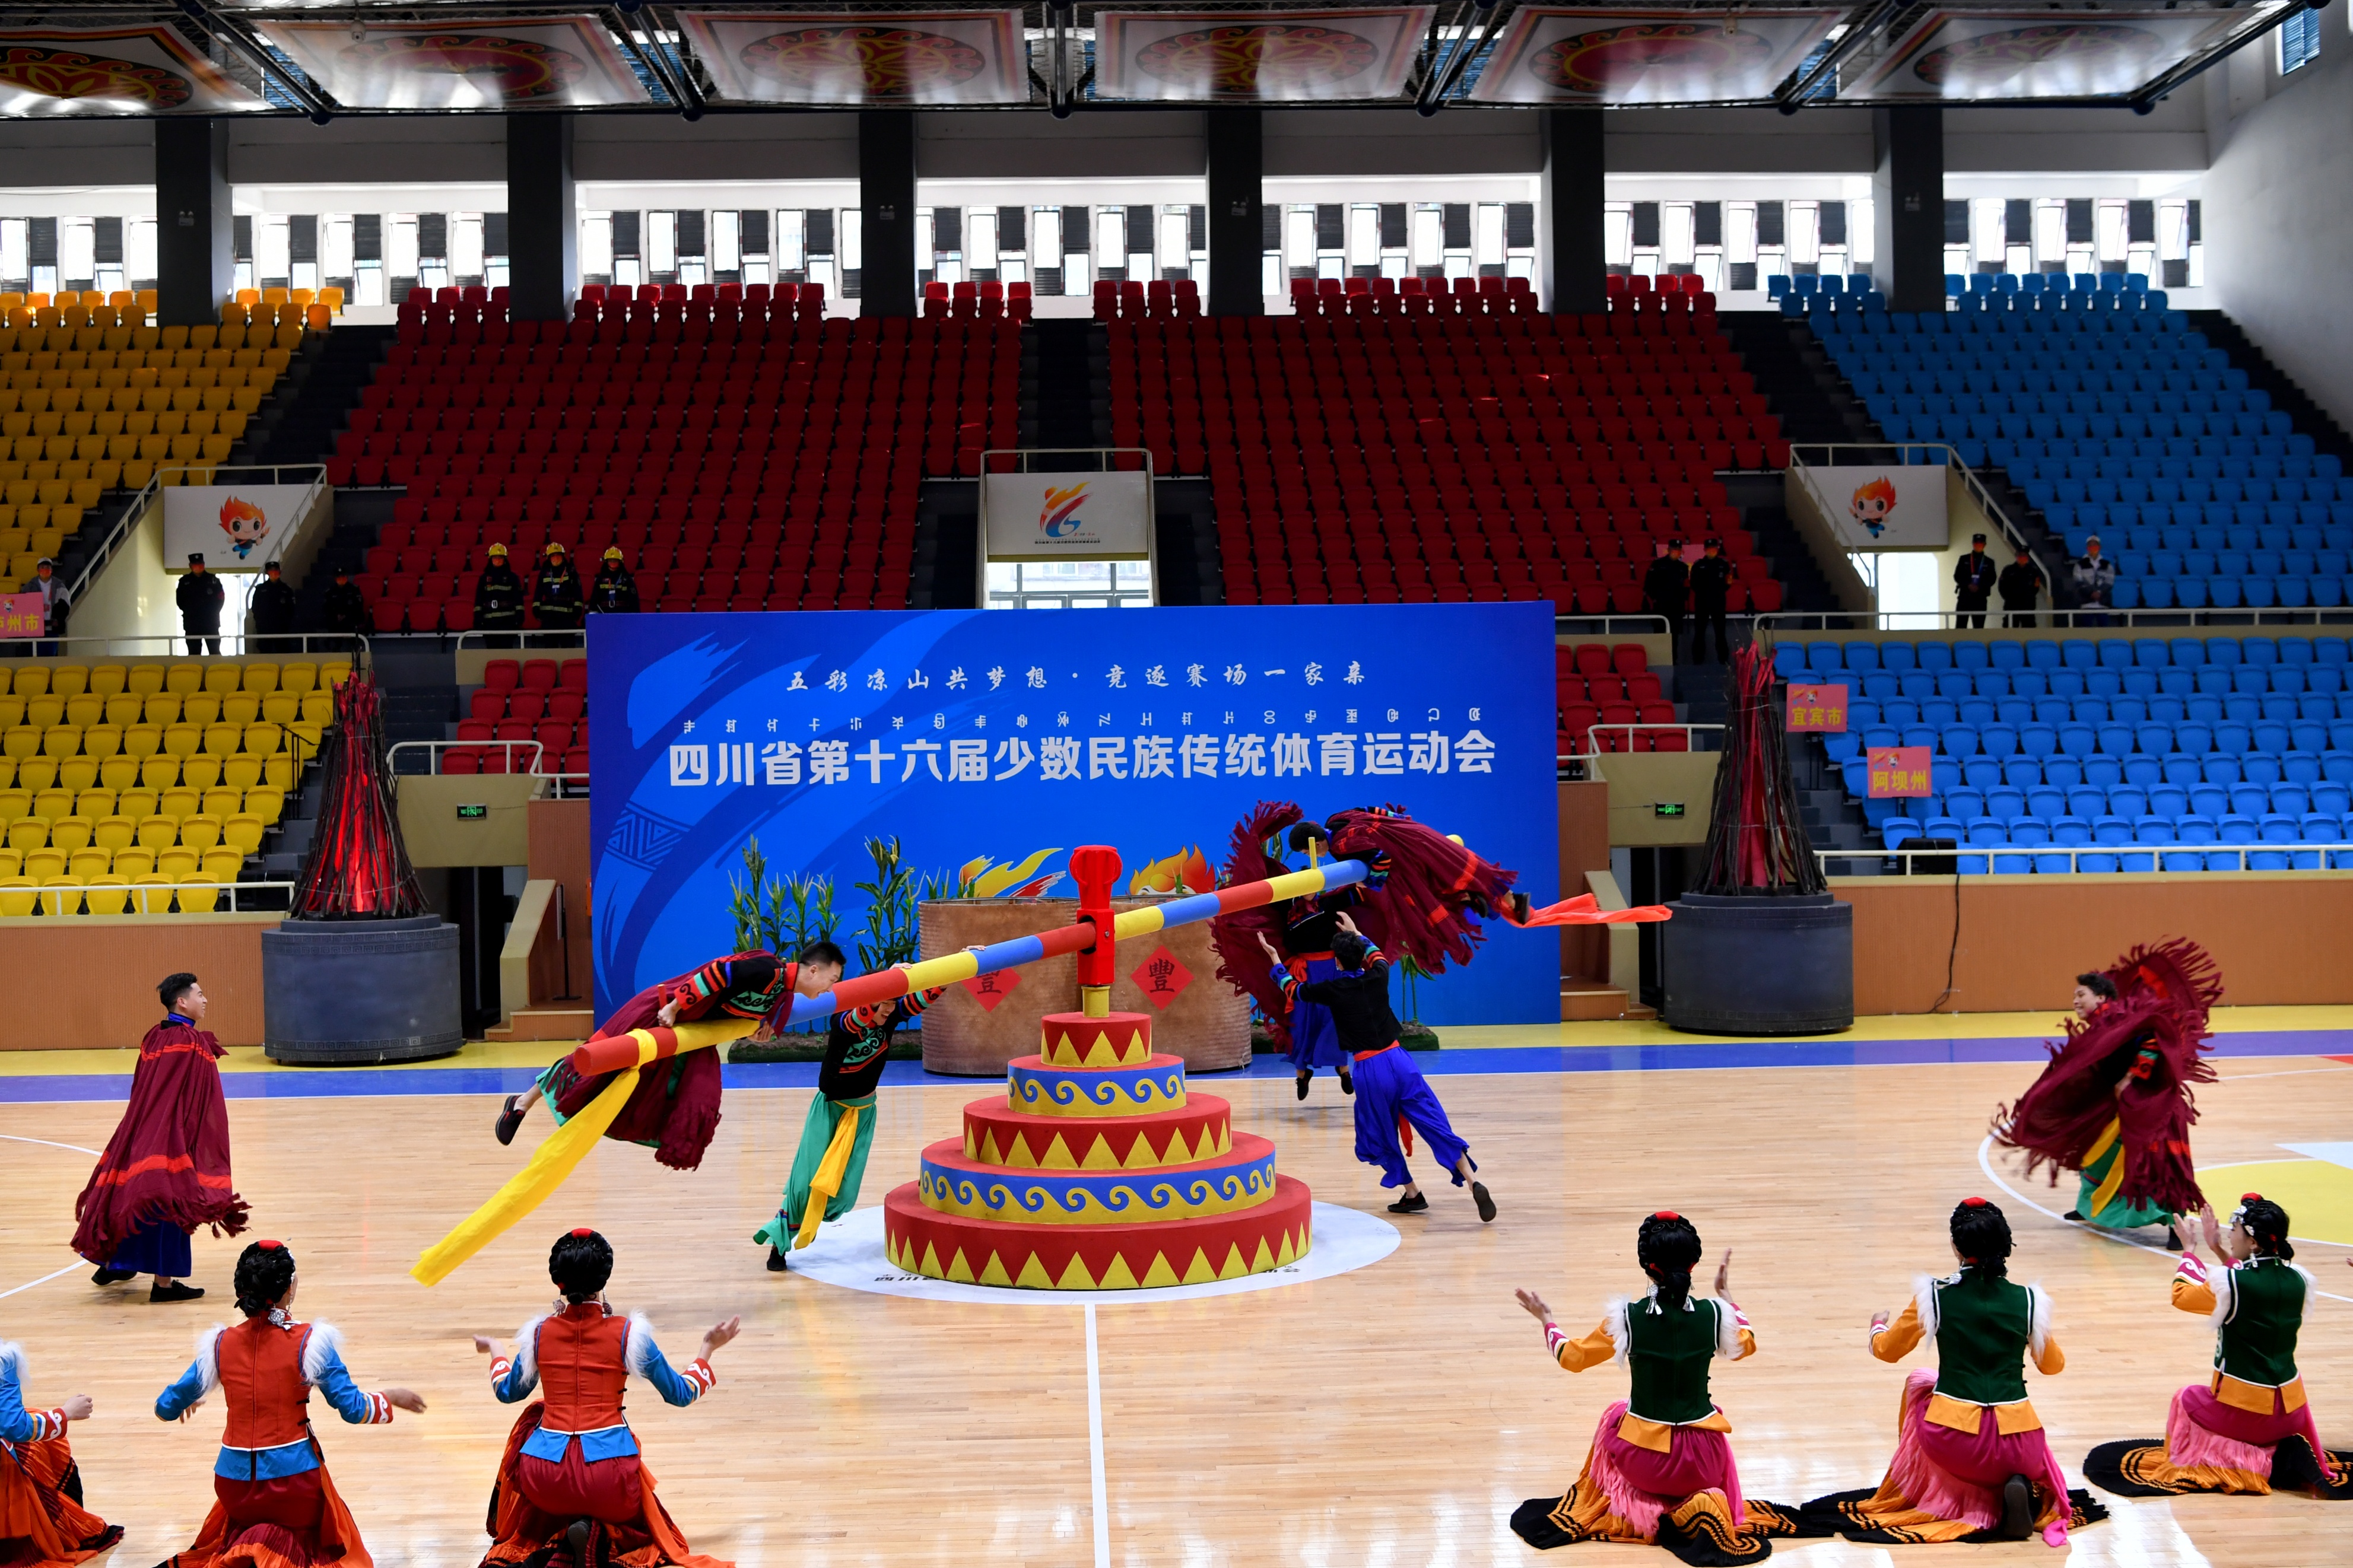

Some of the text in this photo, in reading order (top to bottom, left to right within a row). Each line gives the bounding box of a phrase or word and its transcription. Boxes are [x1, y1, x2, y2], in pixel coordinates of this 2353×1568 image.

[0, 613, 40, 632] 州市
[1792, 707, 1842, 726] 宜宾市
[669, 729, 1495, 786] 四川省第十六届少数民族传统体育运动会
[1872, 770, 1927, 792] 阿坝州
[1149, 958, 1175, 993] 豐
